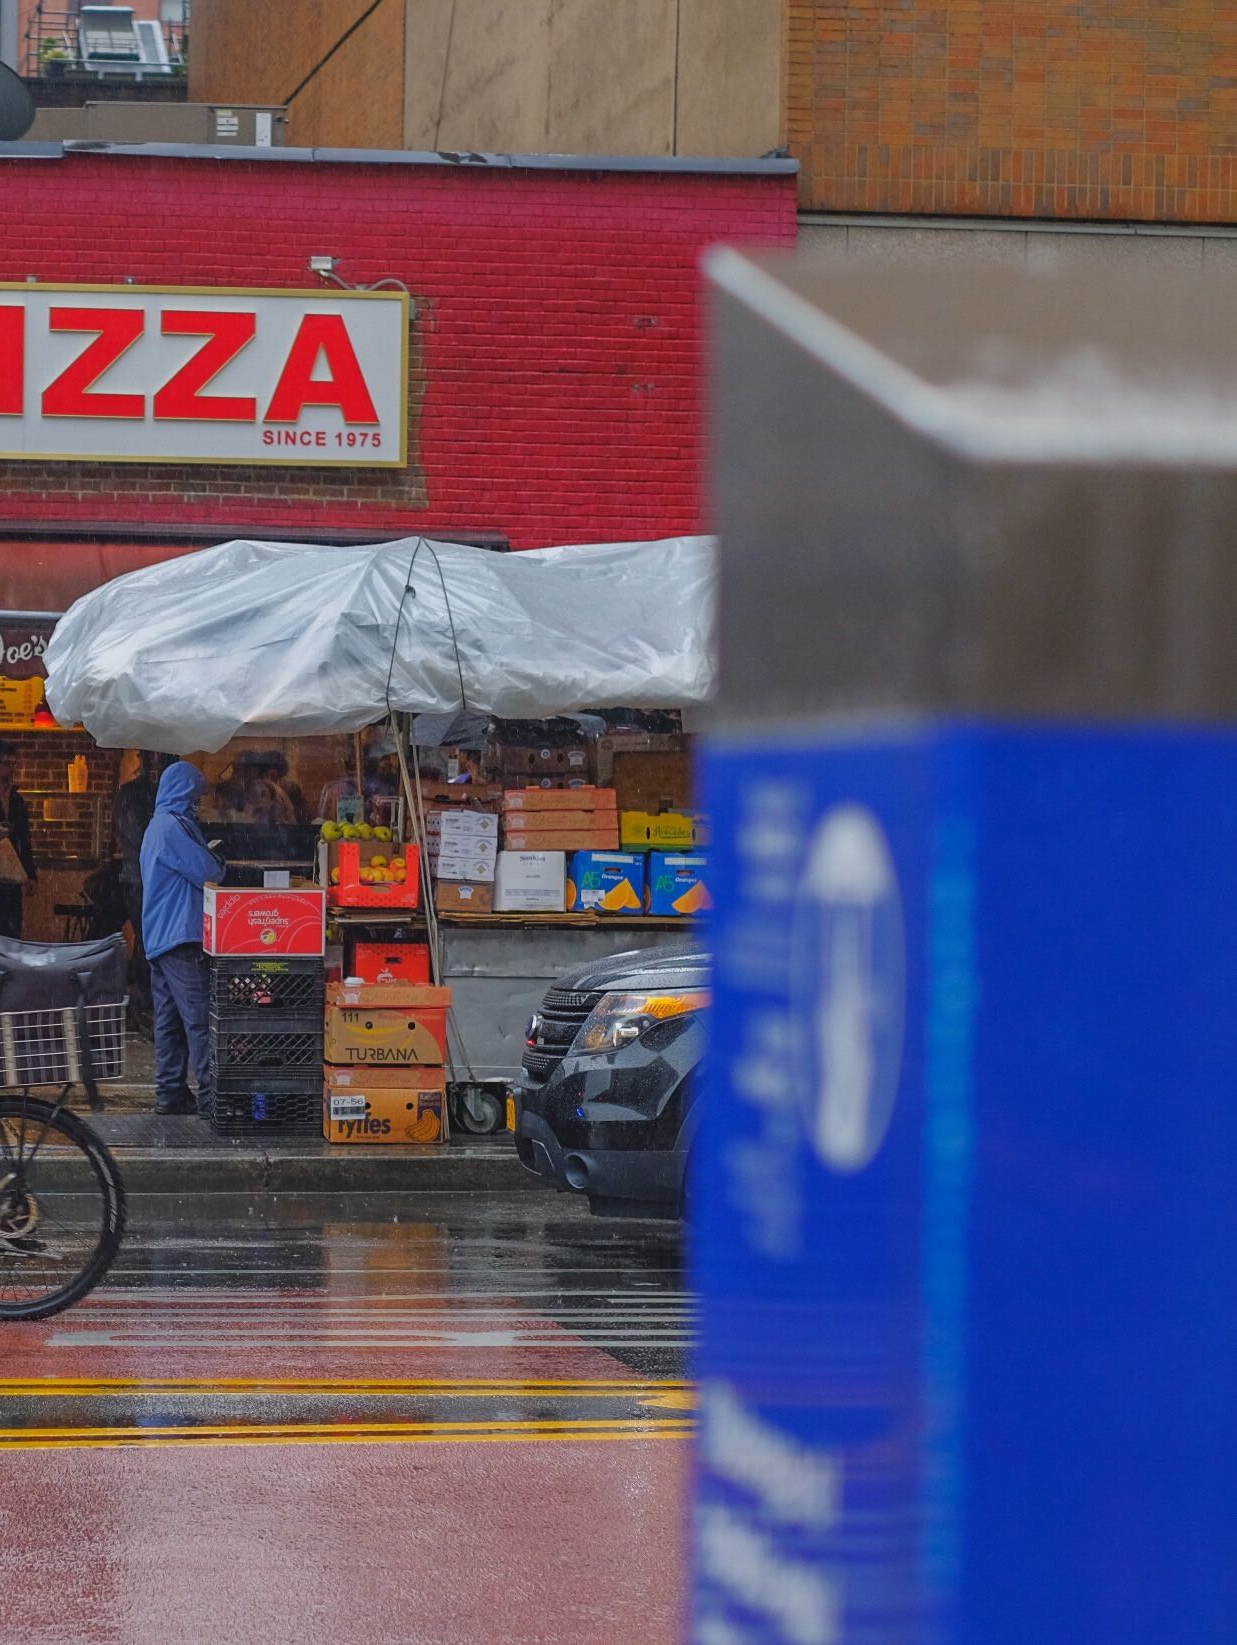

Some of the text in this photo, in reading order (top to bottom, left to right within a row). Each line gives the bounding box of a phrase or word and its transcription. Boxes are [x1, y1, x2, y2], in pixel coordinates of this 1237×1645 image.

[263, 430, 382, 448] SINCE 1975
[342, 1012, 359, 1022] 111
[345, 1047, 419, 1061] TURBANA
[333, 1098, 364, 1106] 07-56
